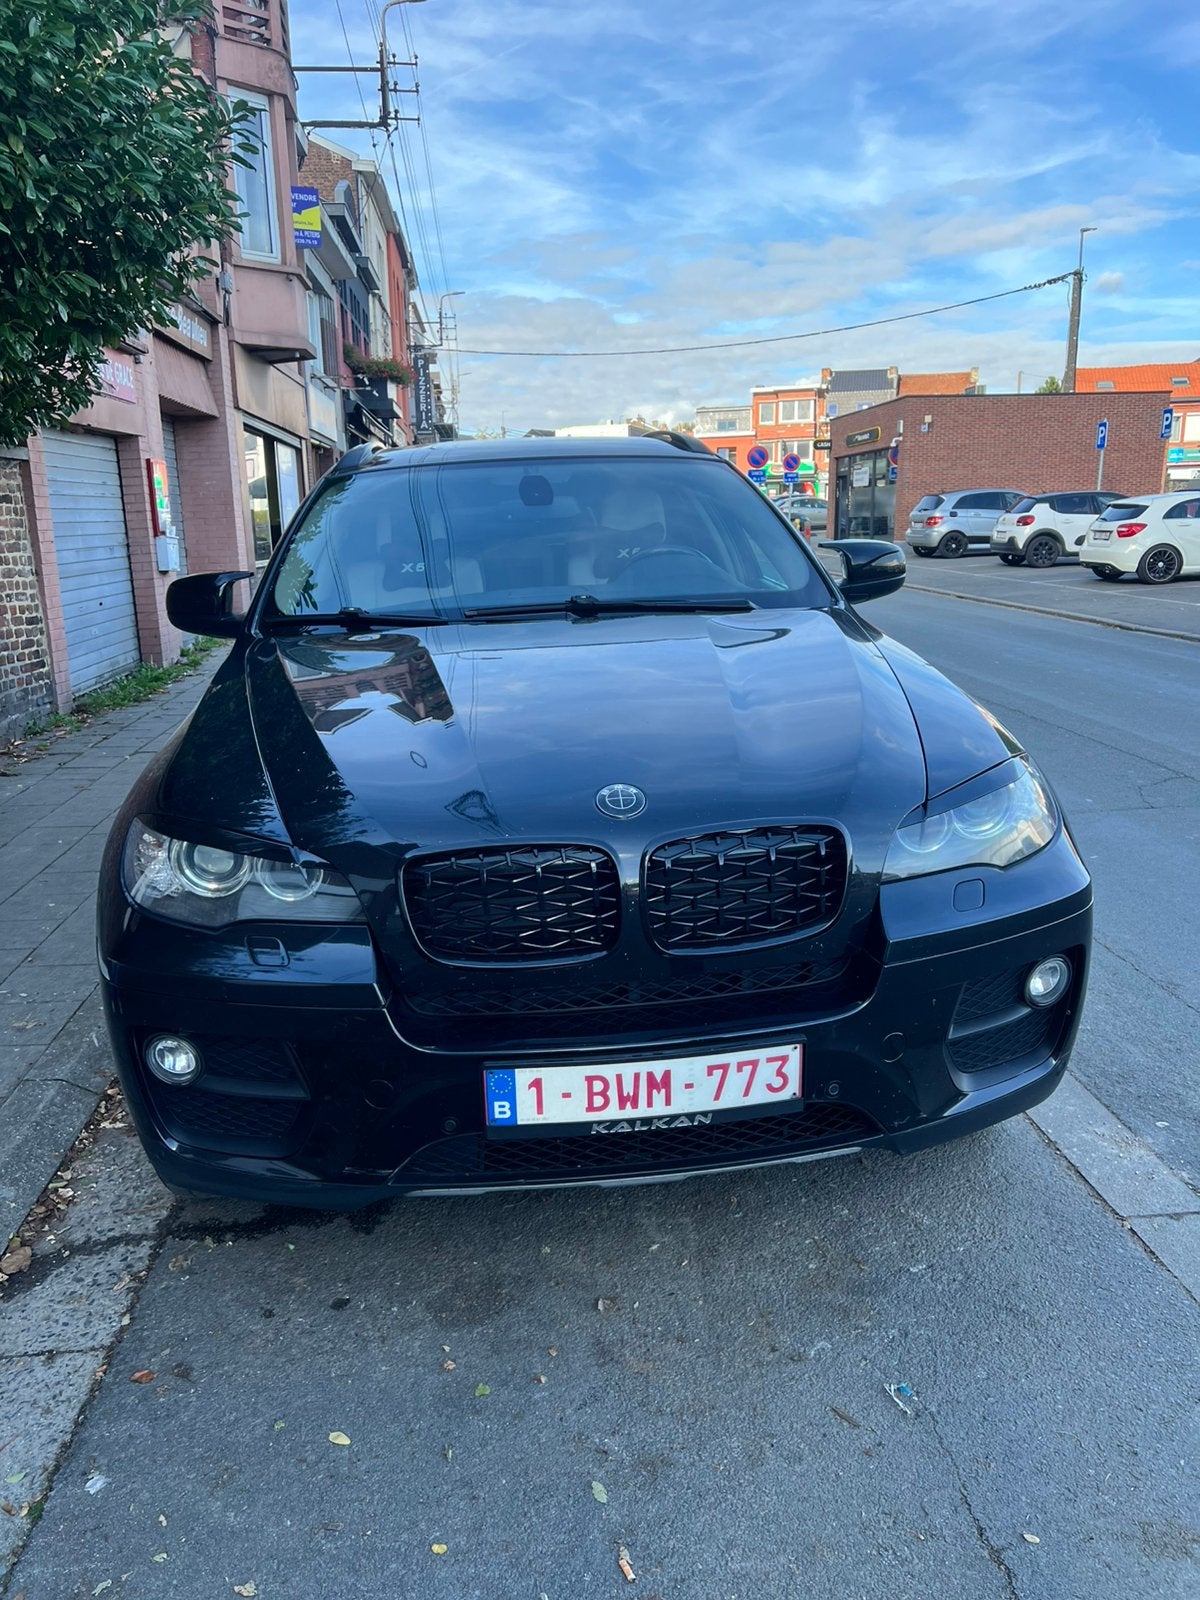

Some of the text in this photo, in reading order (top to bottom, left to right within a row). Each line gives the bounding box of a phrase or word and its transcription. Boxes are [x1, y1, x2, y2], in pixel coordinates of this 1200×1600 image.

[291, 193, 317, 202] VENDRE
[417, 359, 429, 429] PIZZERIA
[1162, 413, 1172, 433] P
[1097, 426, 1106, 445] P
[494, 1101, 511, 1119] B
[590, 1112, 714, 1136] KALKAN
